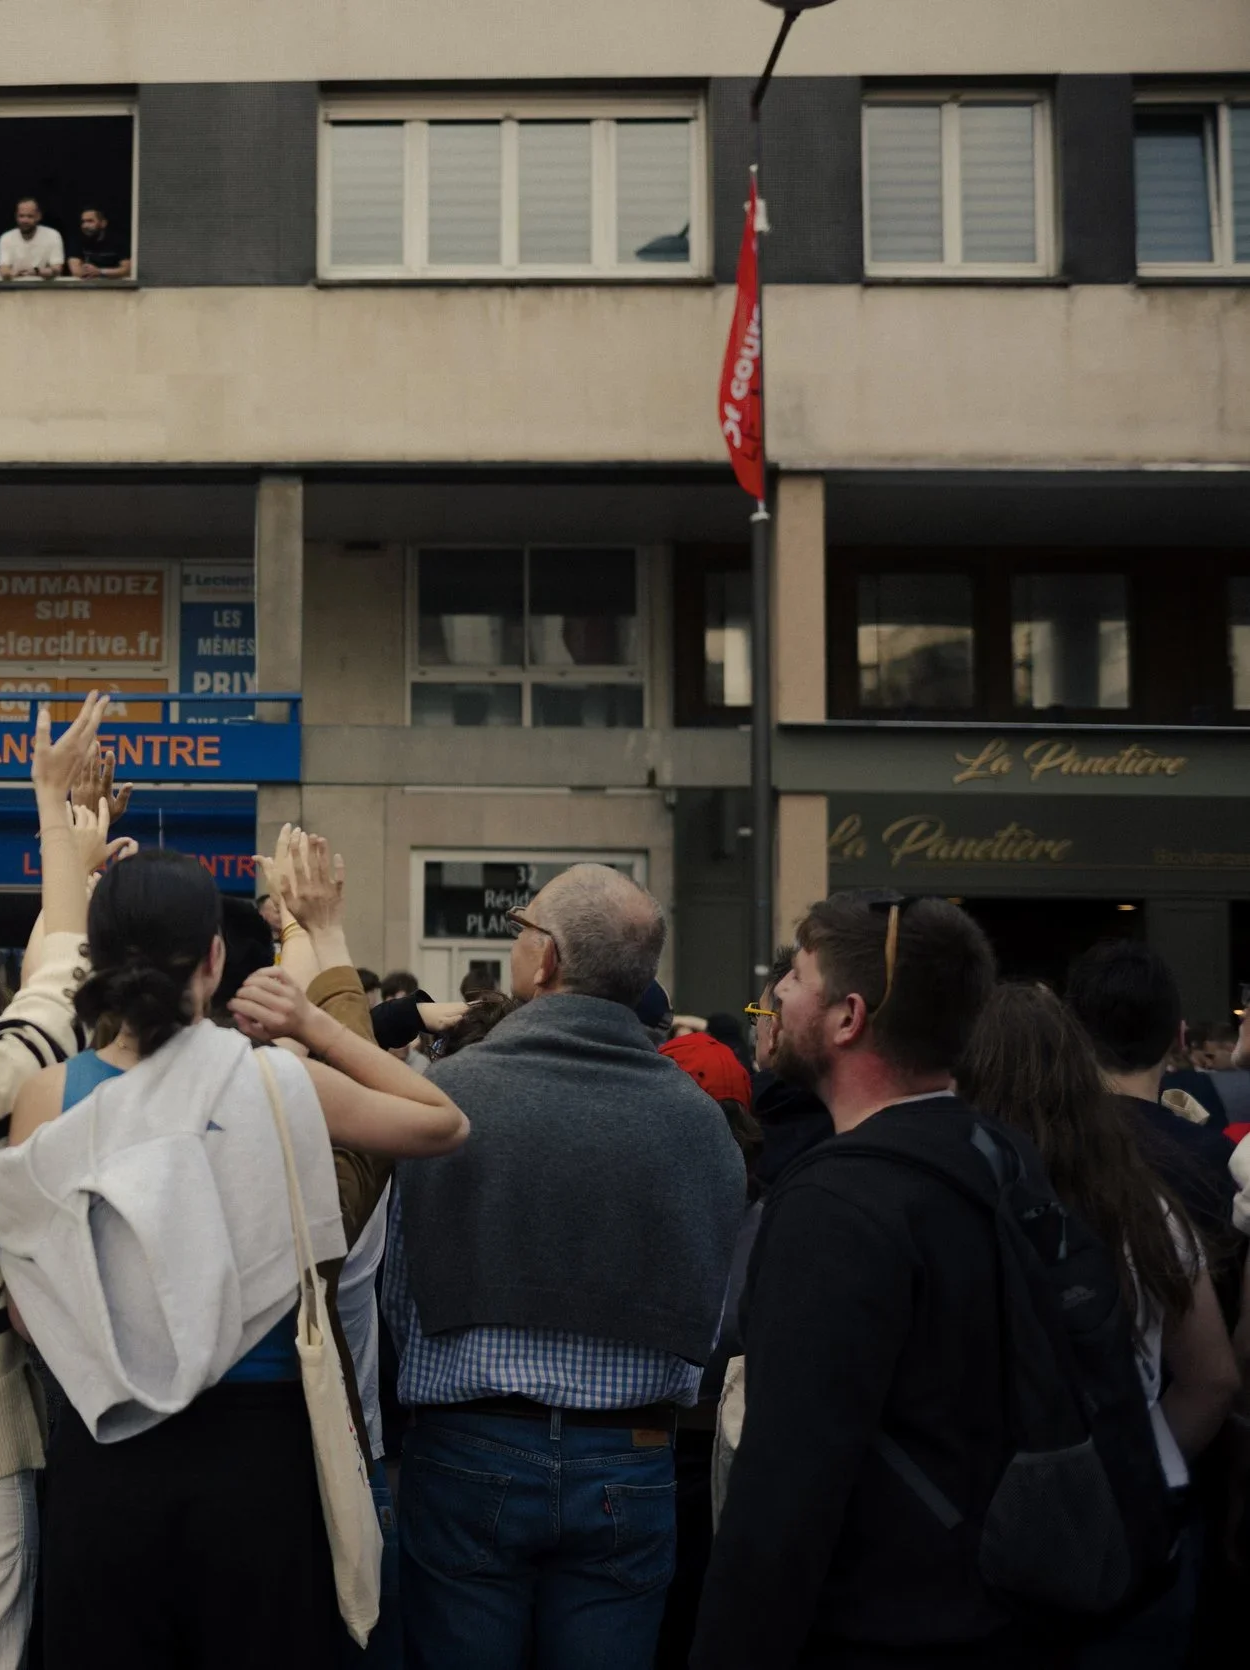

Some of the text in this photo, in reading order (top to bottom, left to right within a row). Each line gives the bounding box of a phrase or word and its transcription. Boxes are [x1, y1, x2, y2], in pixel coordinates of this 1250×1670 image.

[35, 600, 92, 620] SUR
[213, 610, 243, 628] LES
[96, 734, 222, 767] ENTRE
[953, 737, 1189, 784] La Panetière
[882, 814, 1073, 868] Panetière
[484, 888, 531, 910] Résid
